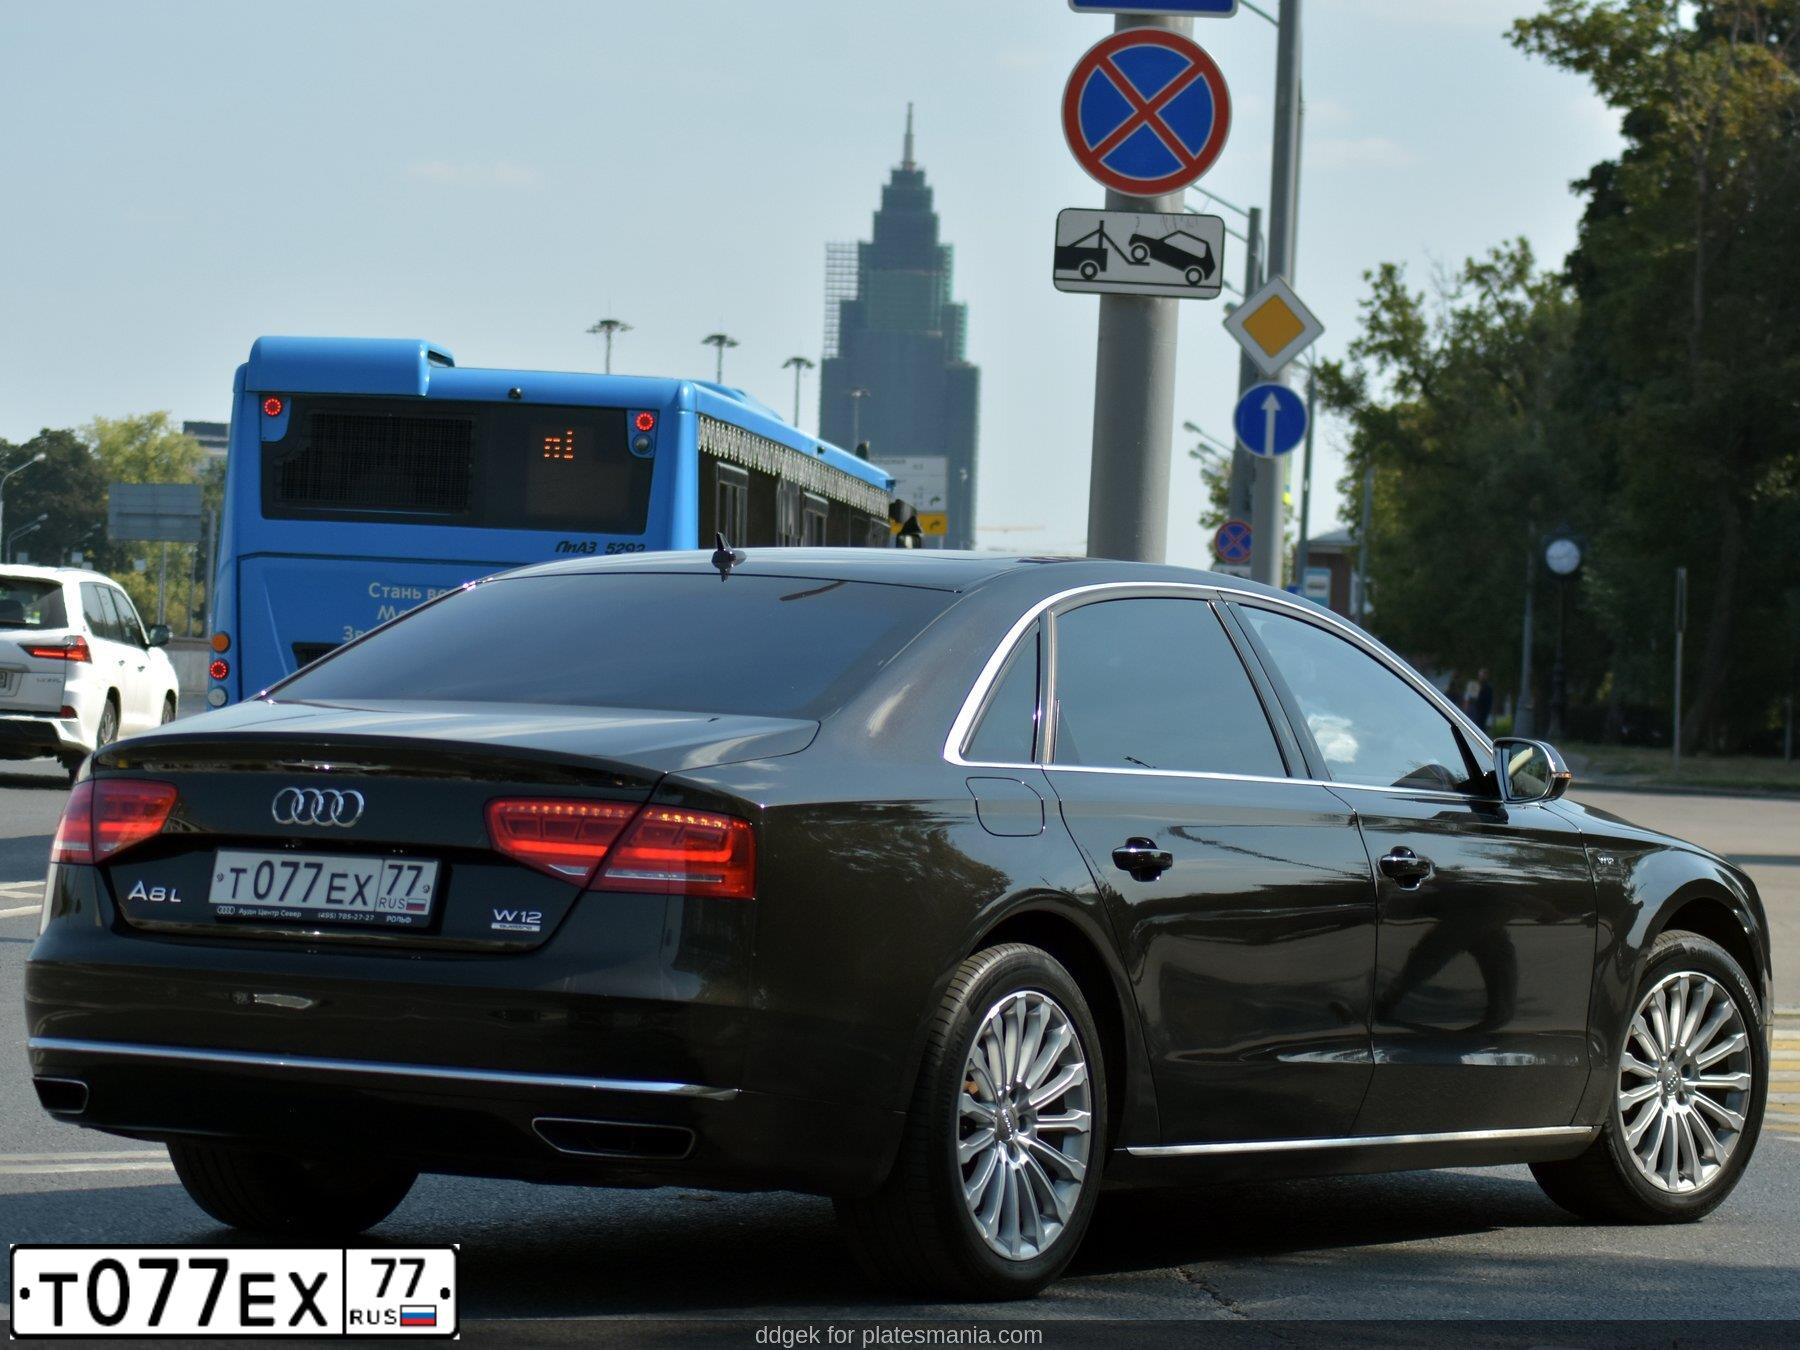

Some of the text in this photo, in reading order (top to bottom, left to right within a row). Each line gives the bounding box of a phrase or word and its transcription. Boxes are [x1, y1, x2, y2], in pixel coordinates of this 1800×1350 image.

[368, 582, 422, 599] Стань
[386, 864, 424, 897] 77
[379, 897, 405, 910] RUS
